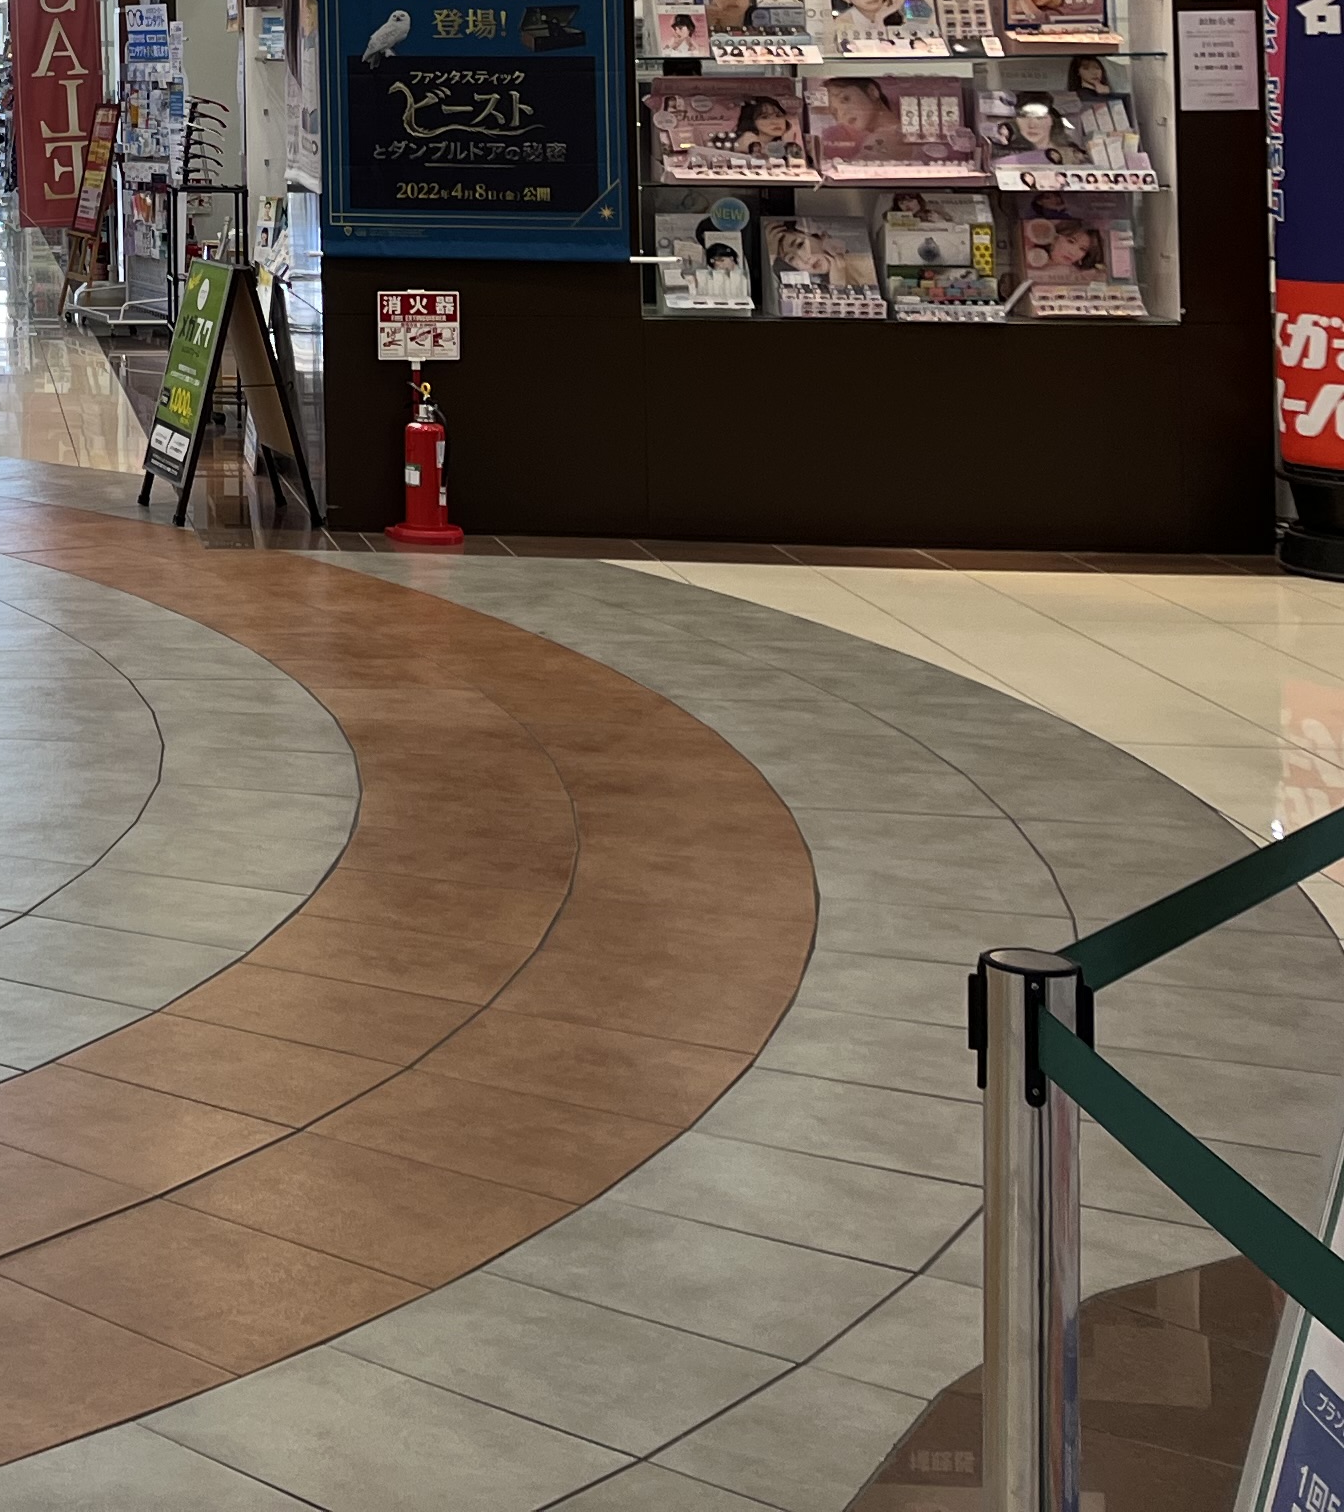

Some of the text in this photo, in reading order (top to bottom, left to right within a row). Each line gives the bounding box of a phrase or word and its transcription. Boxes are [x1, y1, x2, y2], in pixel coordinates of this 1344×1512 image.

[431, 8, 508, 40] 登場!
[409, 70, 526, 85] ファンタスティック
[387, 80, 542, 138] ビースト
[372, 140, 567, 163] とダンブルドアの秘密
[382, 295, 455, 315] 消火器
